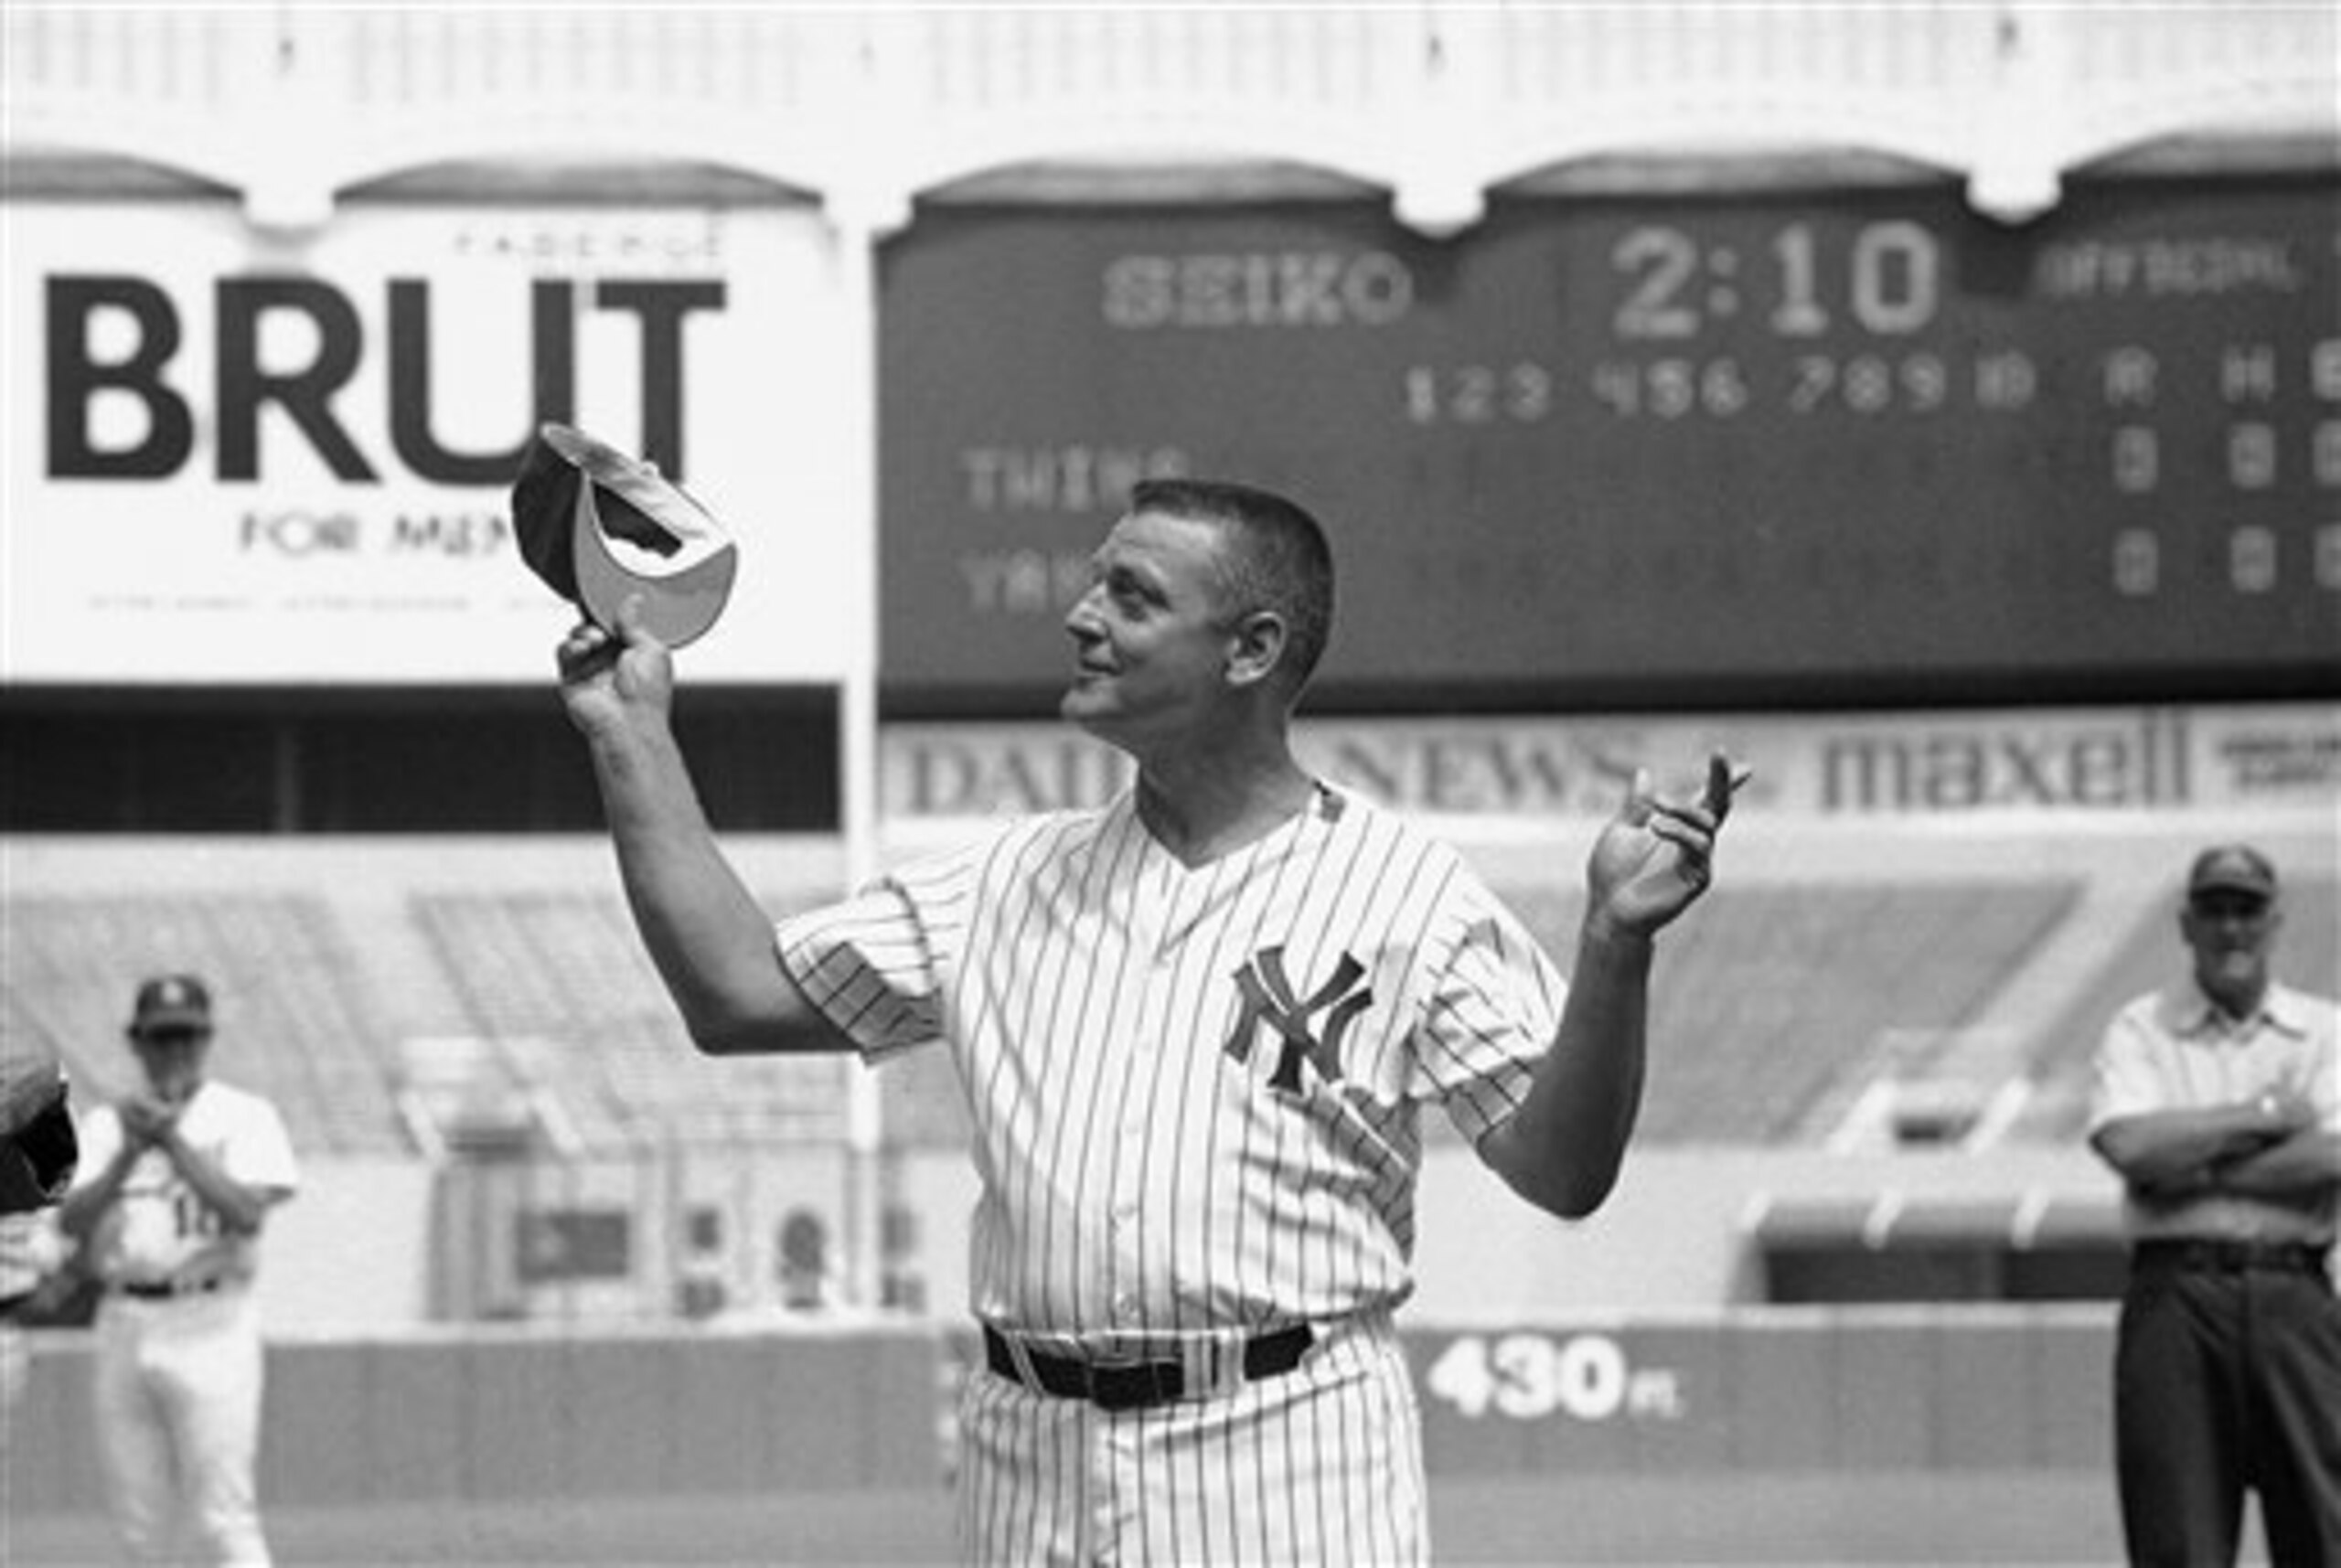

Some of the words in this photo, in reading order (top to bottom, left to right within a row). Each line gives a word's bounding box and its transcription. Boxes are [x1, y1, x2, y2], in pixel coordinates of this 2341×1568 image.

[1103, 250, 1413, 327] SEIKO
[1610, 221, 1939, 336] 2:10
[44, 273, 728, 486] BRUT
[1820, 711, 2193, 813] maxell
[1427, 1334, 1625, 1419] 430
